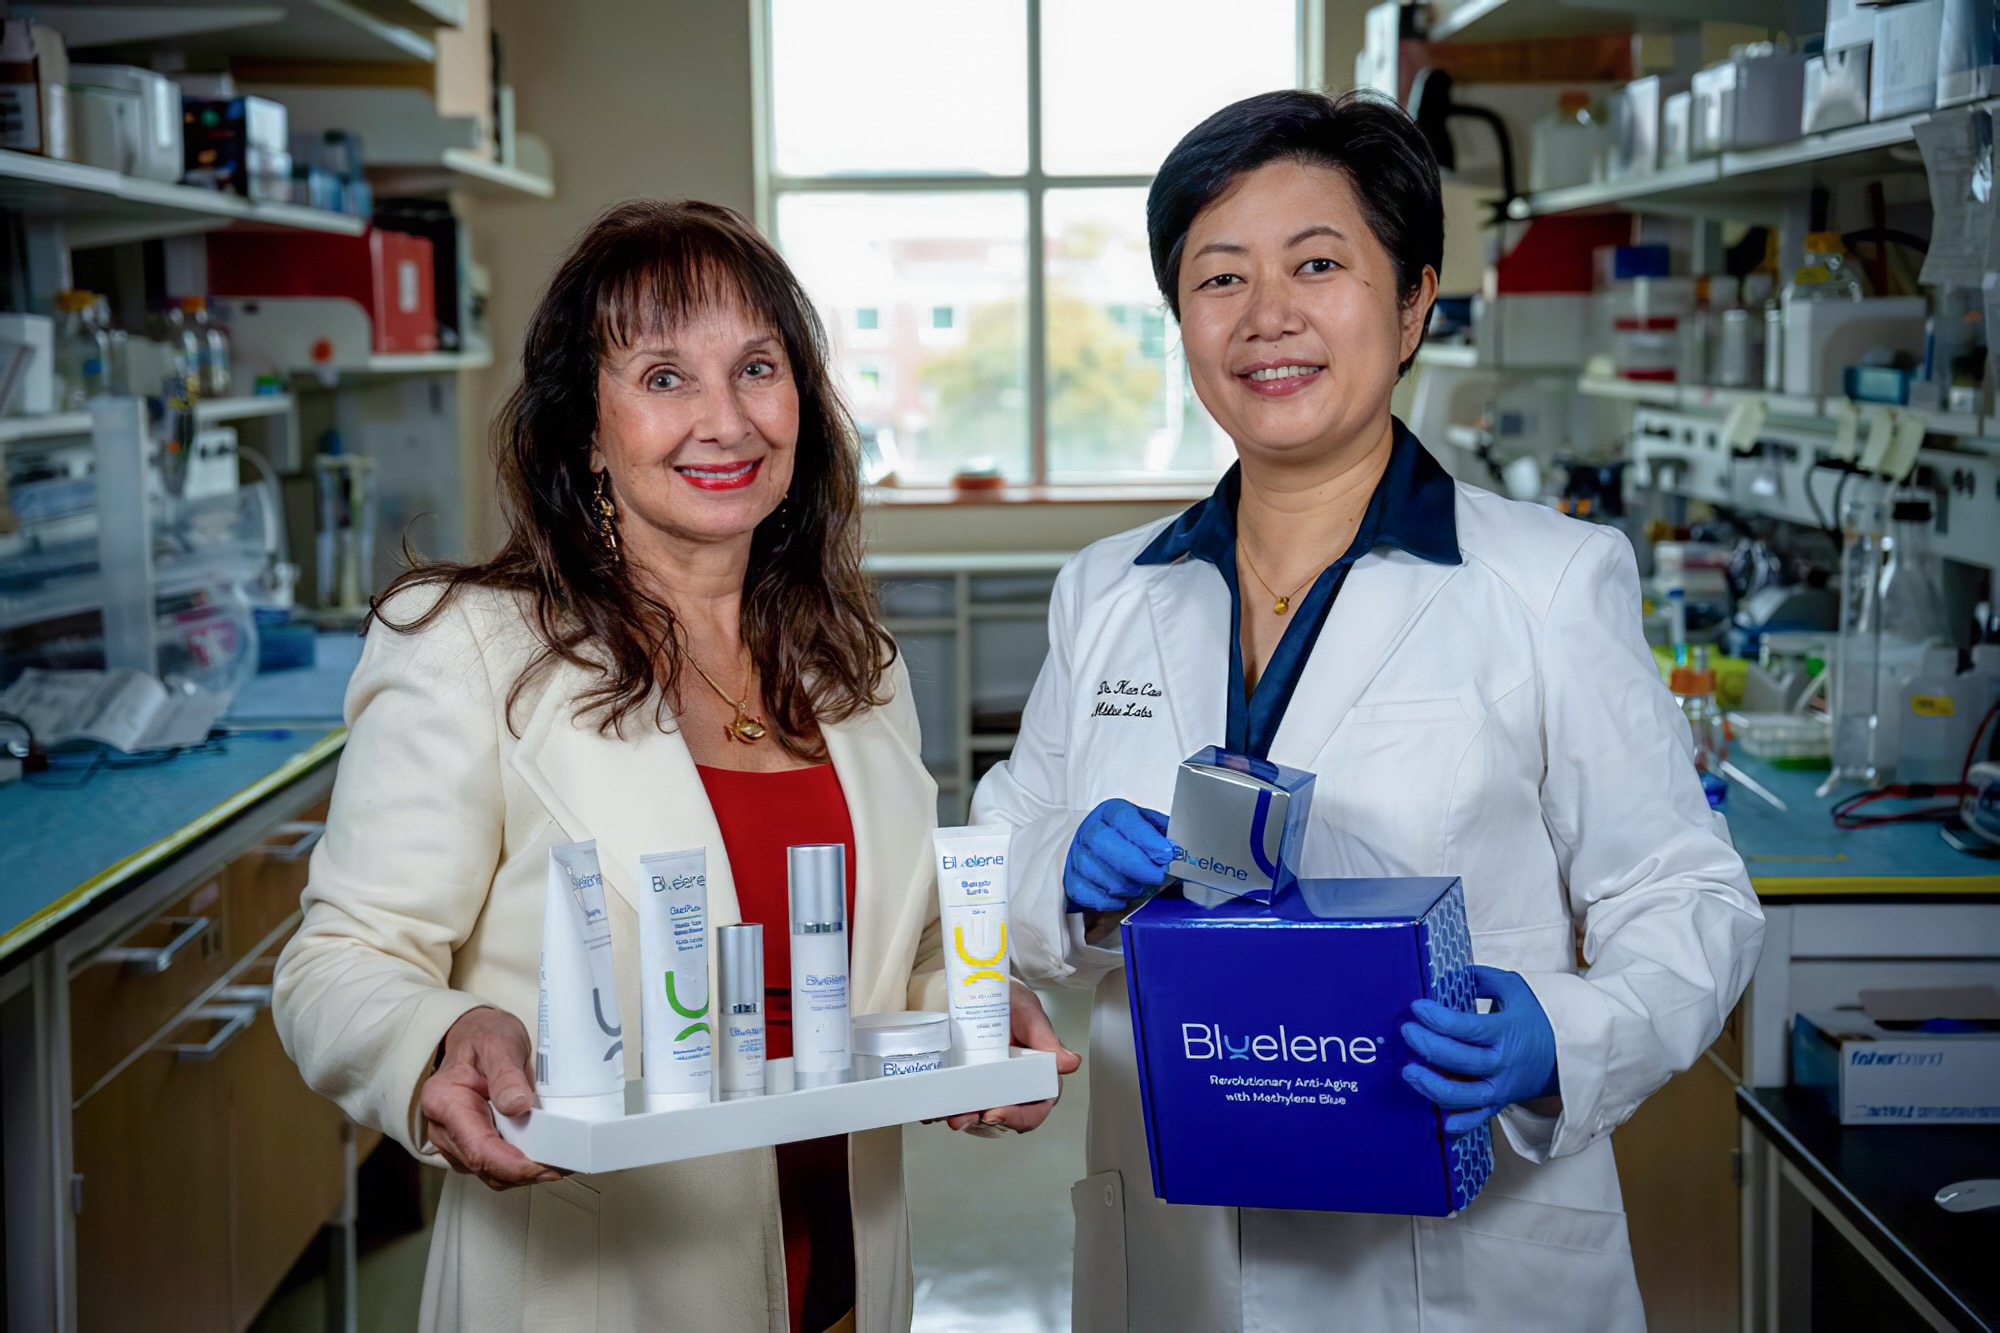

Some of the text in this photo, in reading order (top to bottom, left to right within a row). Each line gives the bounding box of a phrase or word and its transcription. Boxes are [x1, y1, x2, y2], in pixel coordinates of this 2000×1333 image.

[1123, 703, 1152, 717] Labs
[942, 855, 1004, 869] Blelene
[1225, 1091, 1251, 1102] with
